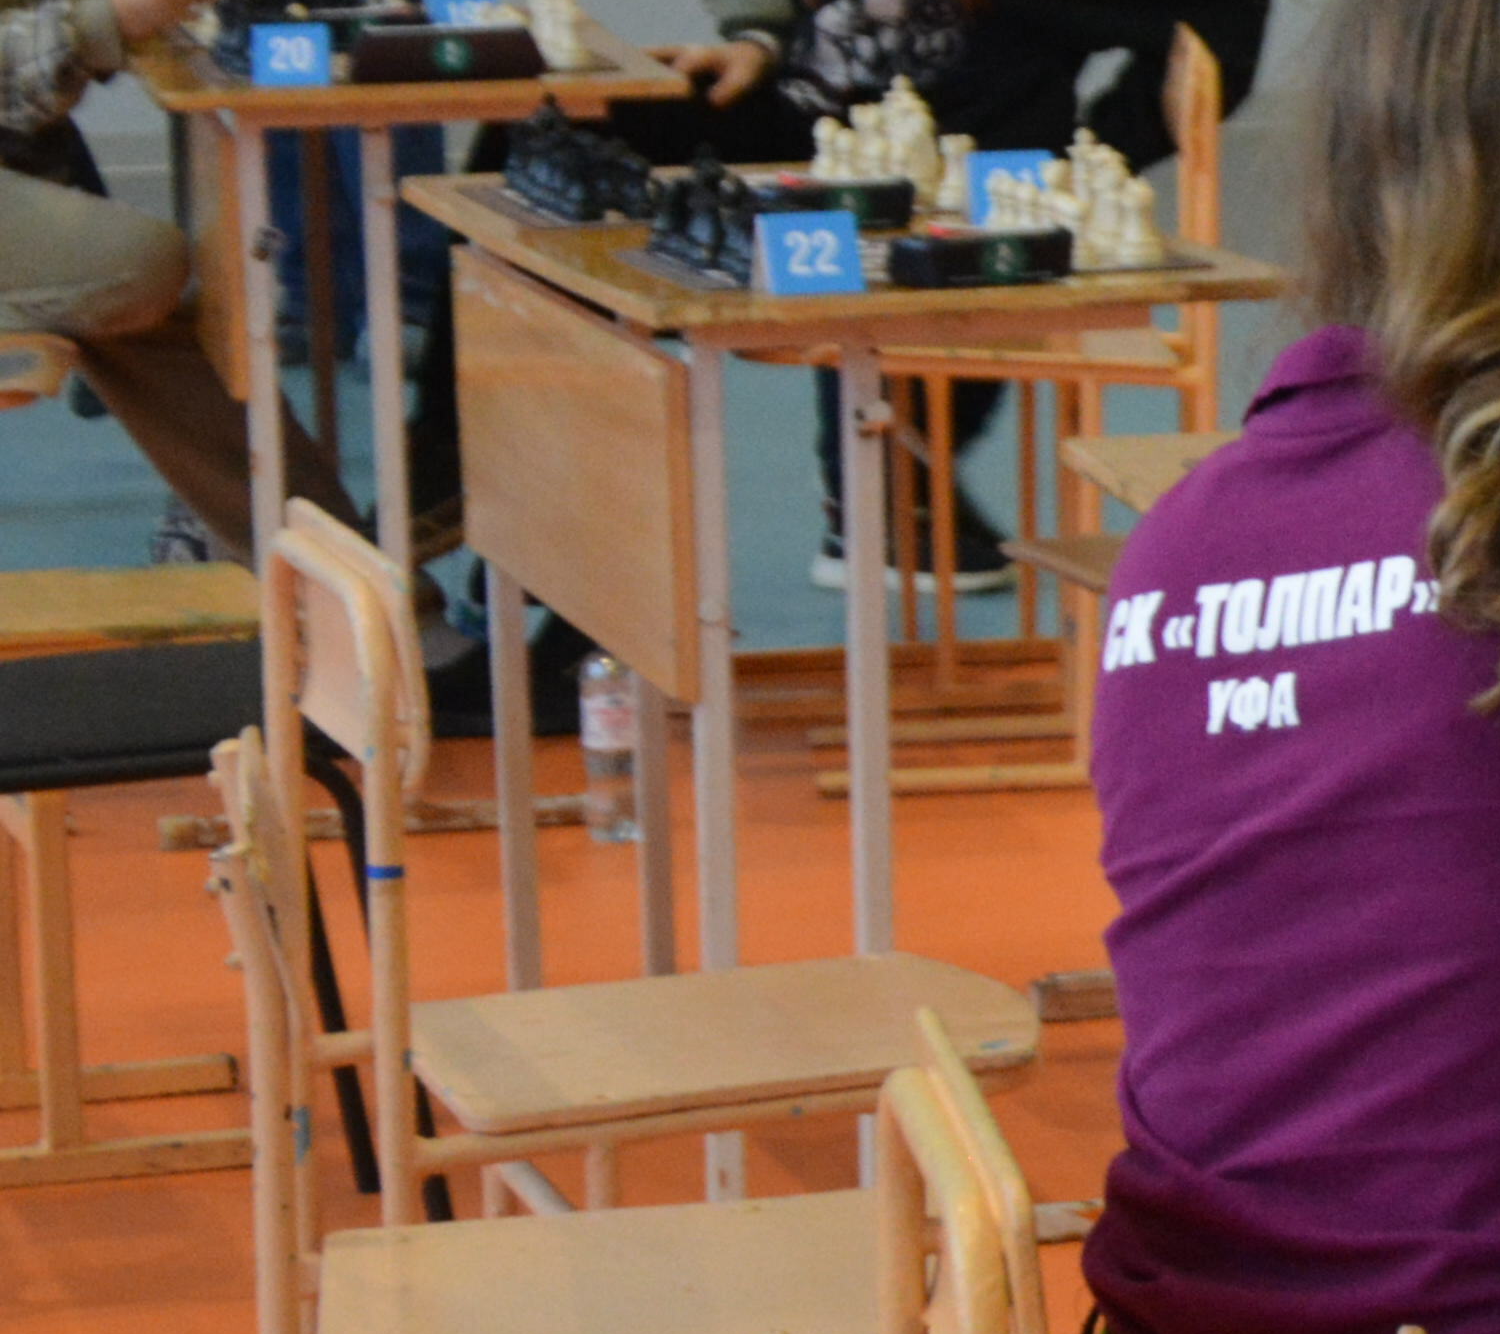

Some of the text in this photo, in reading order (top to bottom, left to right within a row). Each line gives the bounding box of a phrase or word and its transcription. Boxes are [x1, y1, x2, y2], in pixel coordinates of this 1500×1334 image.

[267, 36, 315, 71] 20
[783, 229, 843, 276] 22
[1206, 671, 1299, 735] УФА
